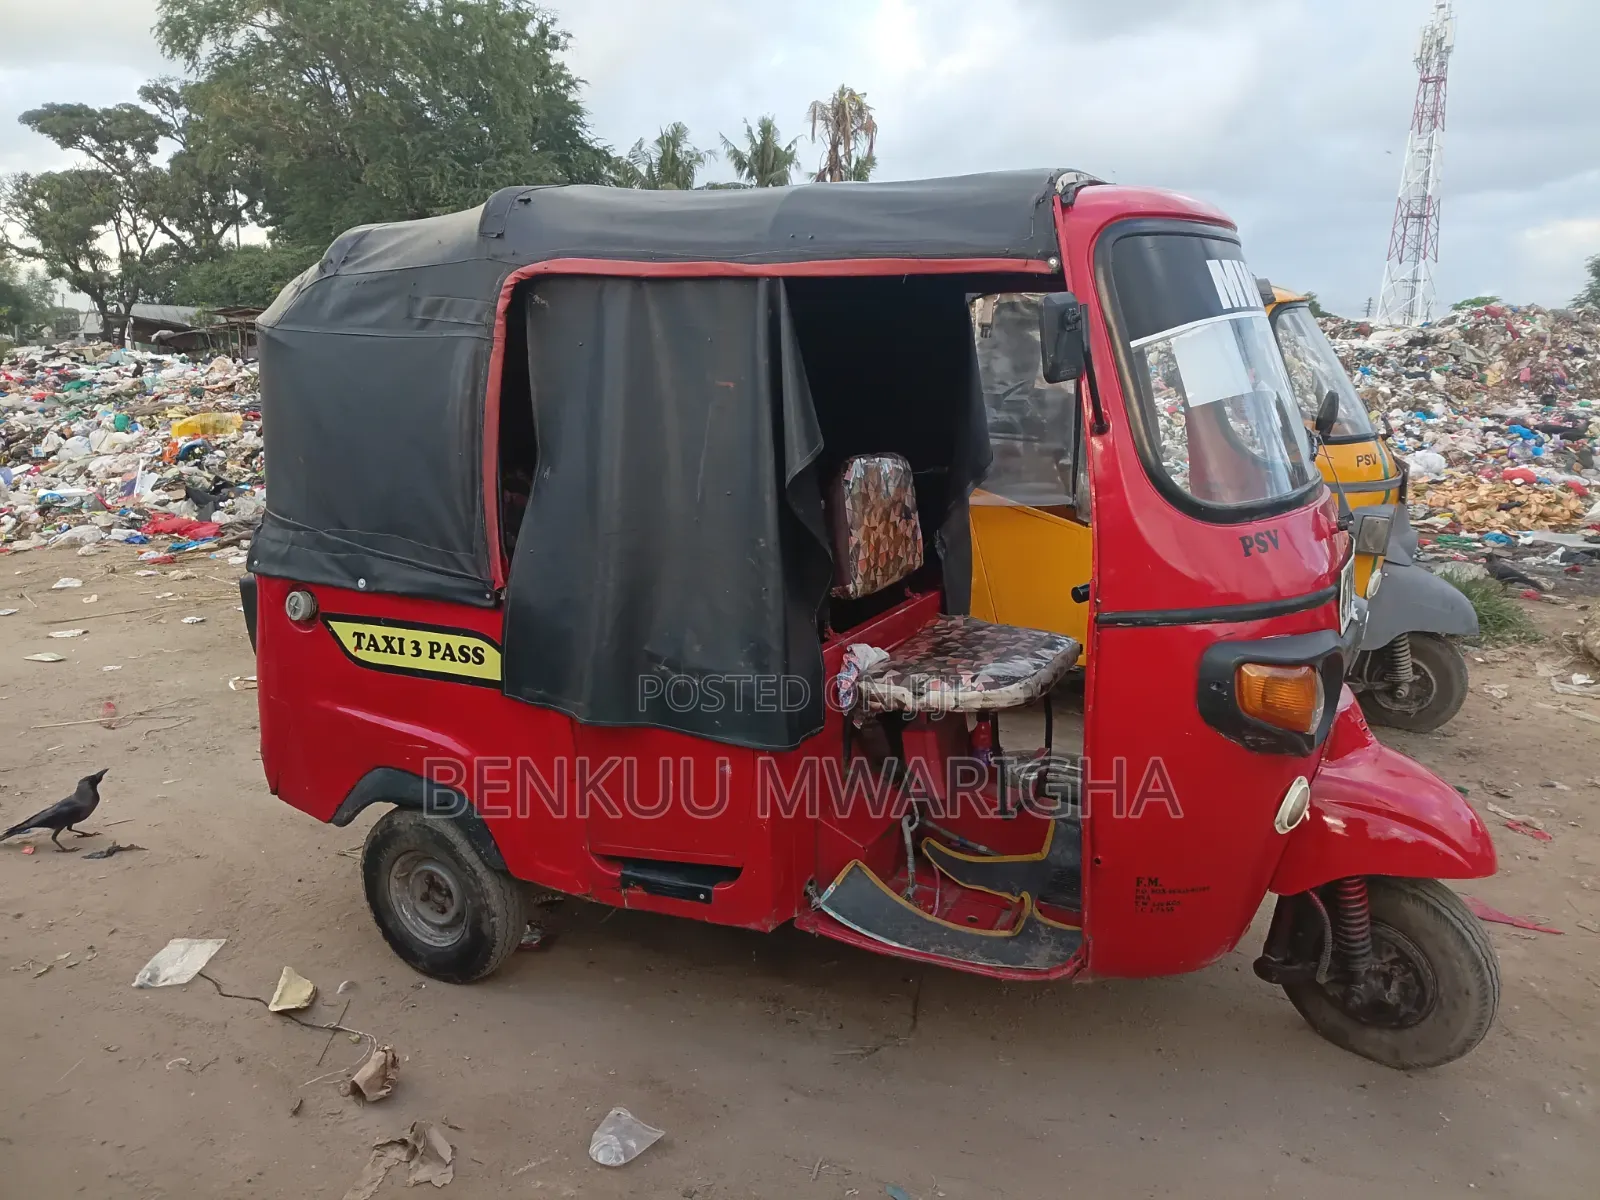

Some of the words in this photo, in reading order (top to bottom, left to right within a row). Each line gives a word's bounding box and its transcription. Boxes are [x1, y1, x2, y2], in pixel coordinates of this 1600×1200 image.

[1356, 454, 1377, 468] PSV
[1240, 529, 1280, 557] PSV
[353, 631, 405, 656] TAXI
[410, 640, 422, 658] 3
[429, 641, 485, 665] PASS
